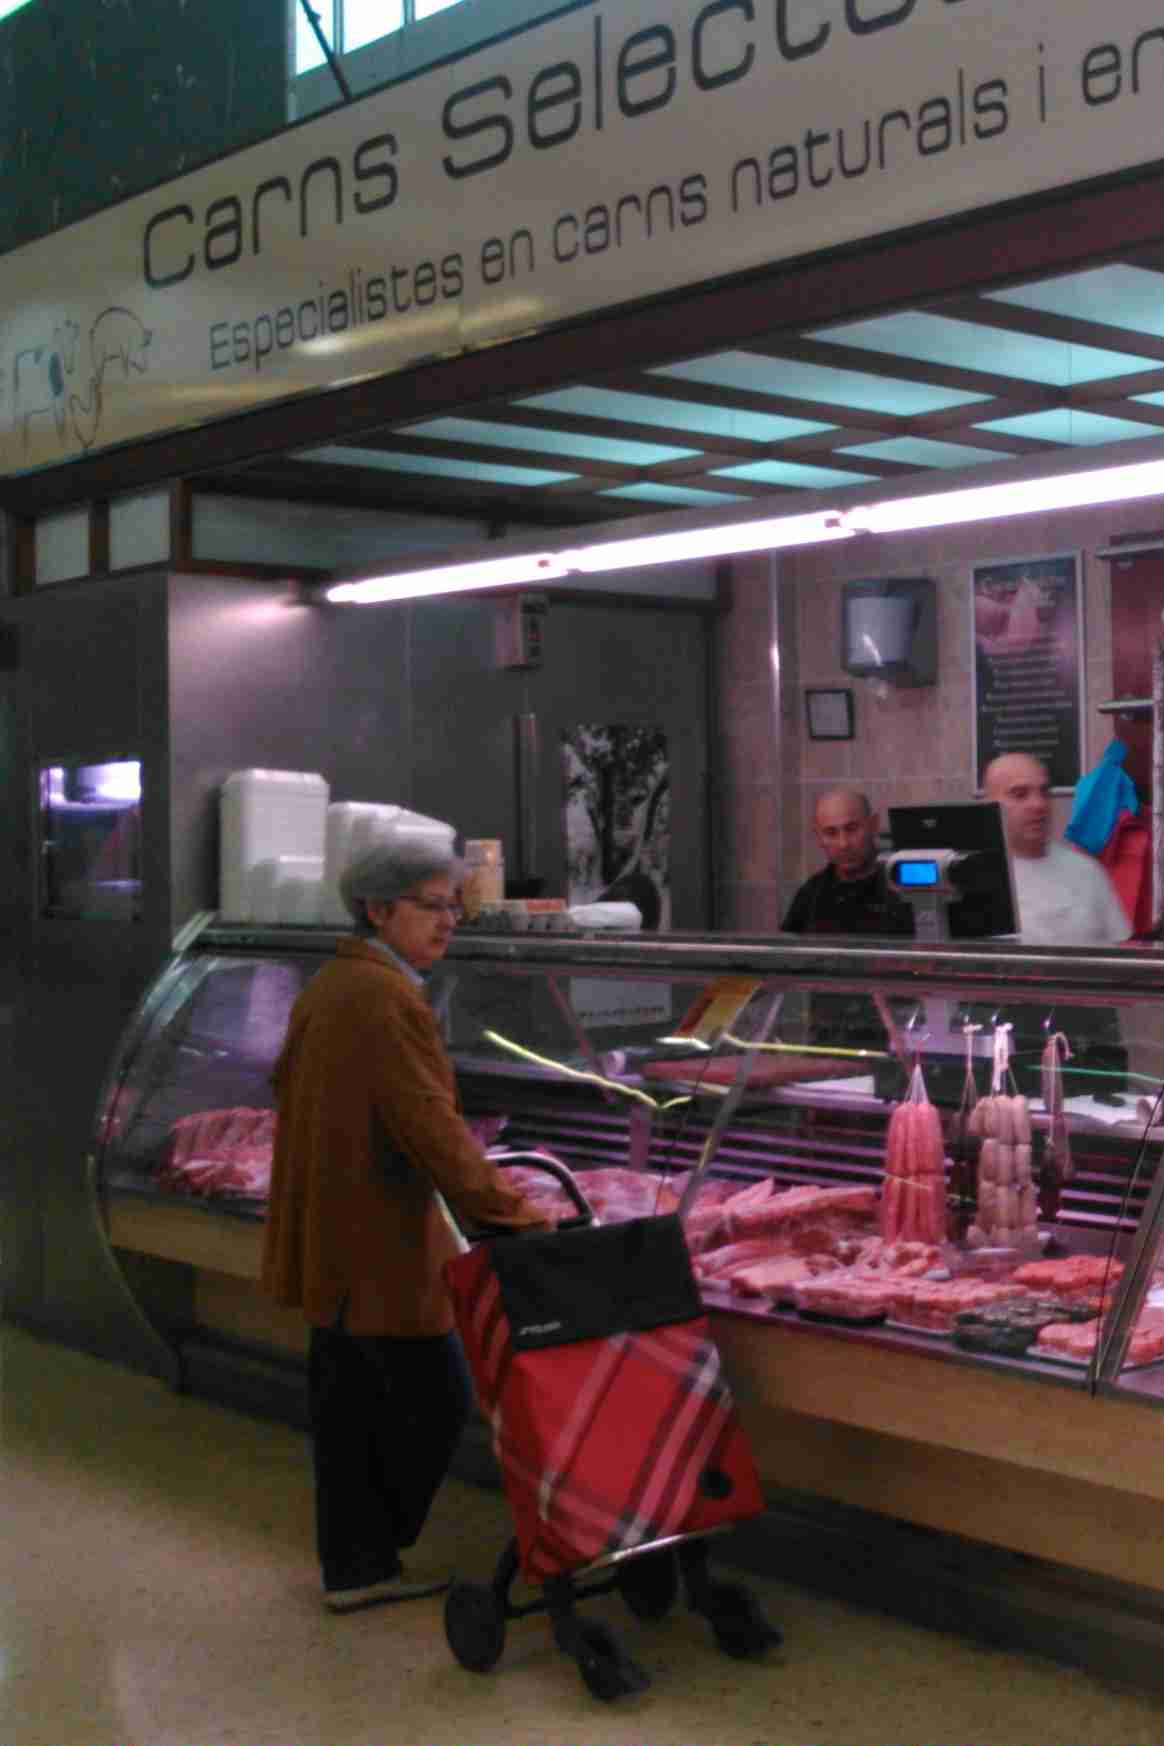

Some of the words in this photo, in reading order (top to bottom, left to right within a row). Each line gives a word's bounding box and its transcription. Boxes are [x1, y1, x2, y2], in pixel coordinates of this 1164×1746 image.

[143, 132, 398, 289] Carns
[441, 0, 968, 180] Select
[208, 252, 463, 372] Especialistes
[480, 227, 535, 285] en
[552, 172, 707, 264] carns
[731, 67, 1009, 212] naturals
[1038, 43, 1047, 122] i
